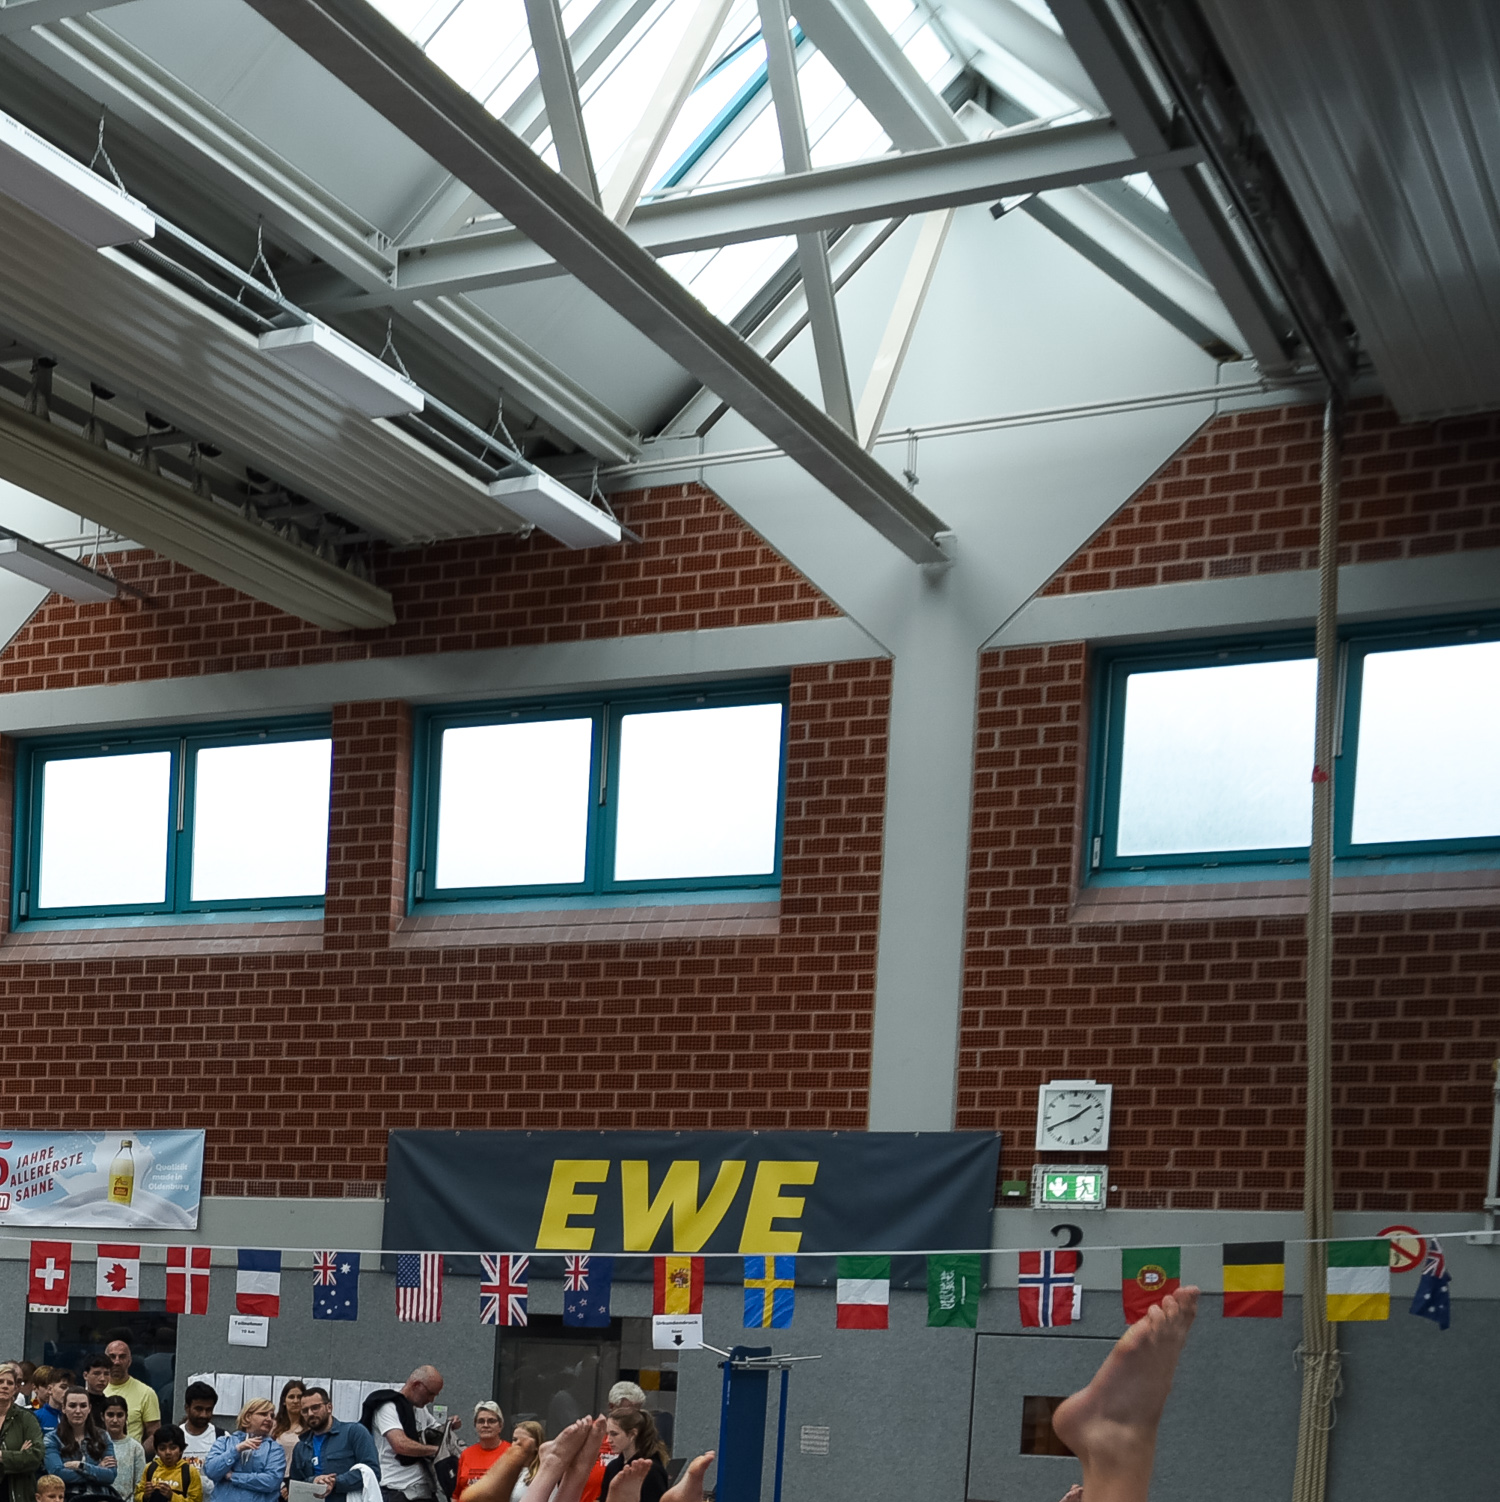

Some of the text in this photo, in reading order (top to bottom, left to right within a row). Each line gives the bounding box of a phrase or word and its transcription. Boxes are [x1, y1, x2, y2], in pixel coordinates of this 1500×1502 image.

[16, 1145, 55, 1169] JAHRE
[10, 1151, 84, 1188] ALLERERSTE
[15, 1178, 55, 1202] SAHNE
[148, 1182, 190, 1191] Oldenburg
[535, 1160, 819, 1253] EWE
